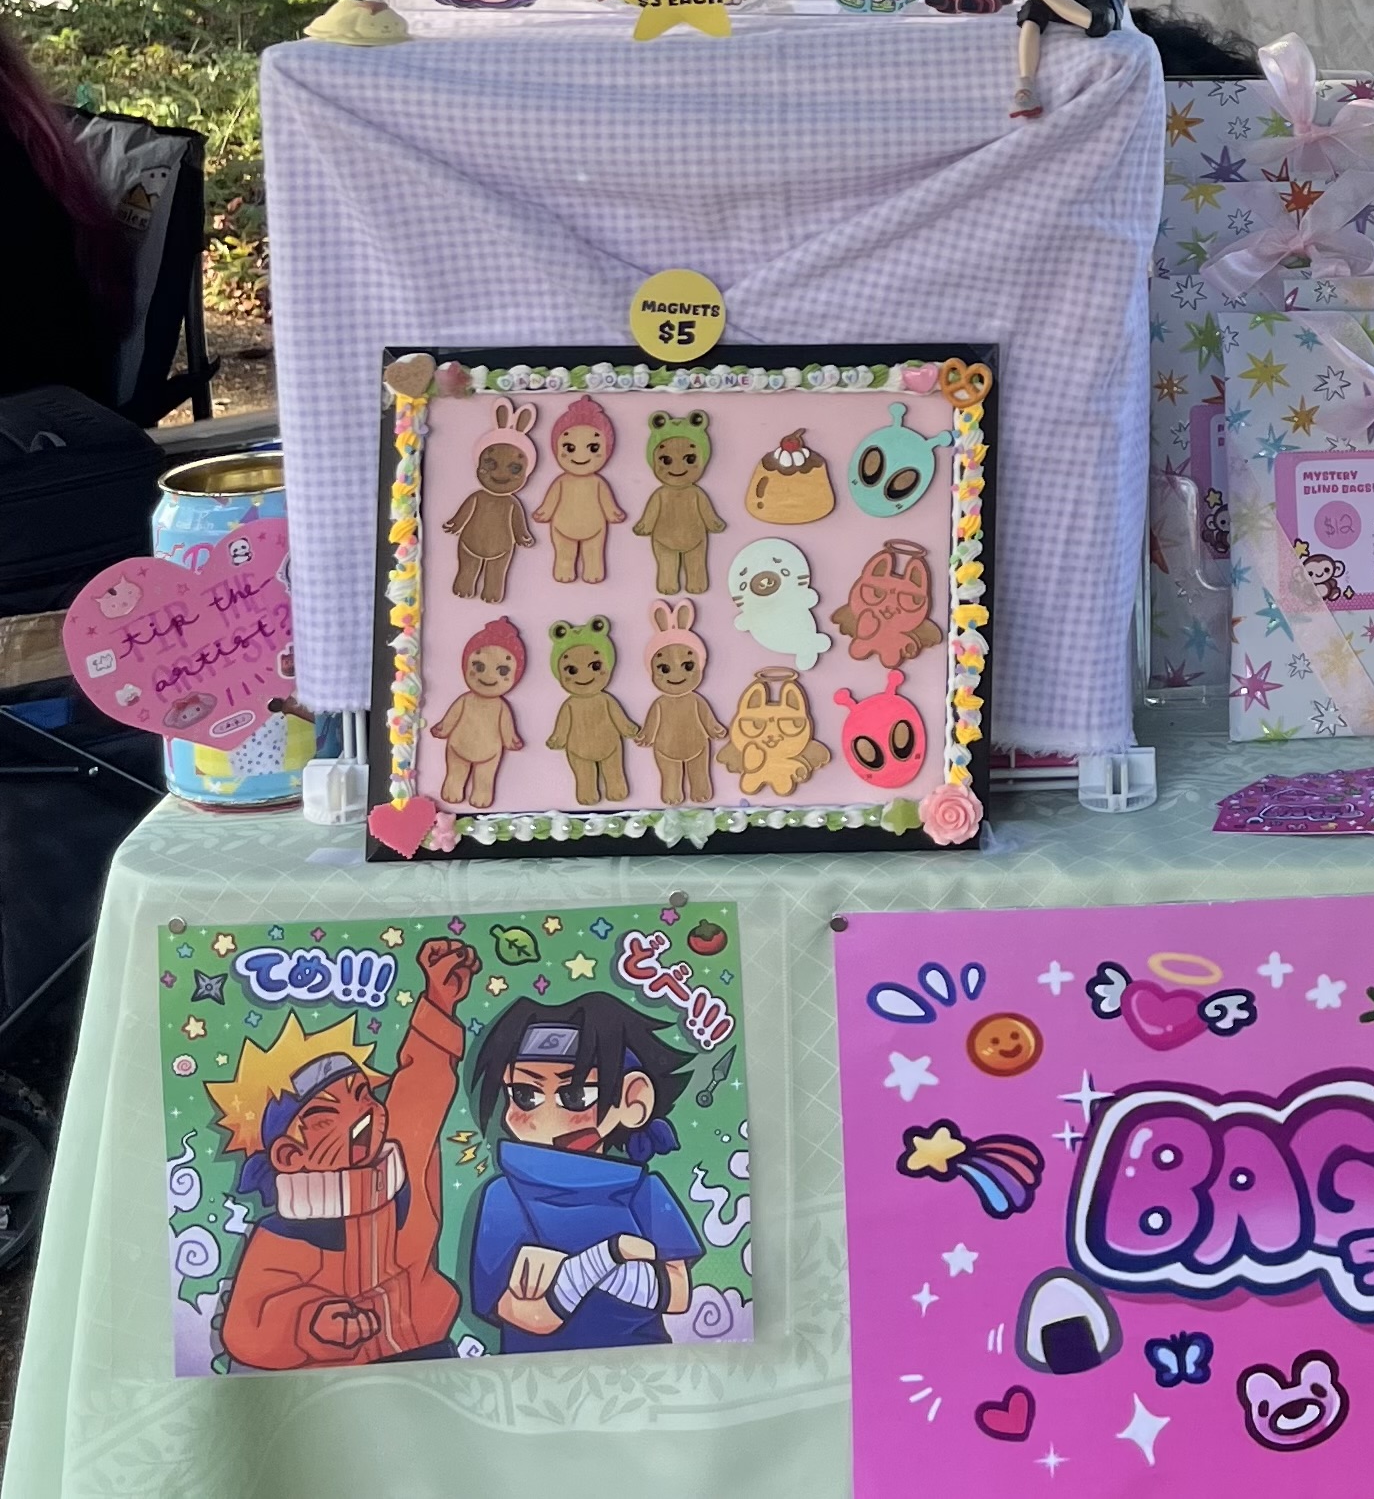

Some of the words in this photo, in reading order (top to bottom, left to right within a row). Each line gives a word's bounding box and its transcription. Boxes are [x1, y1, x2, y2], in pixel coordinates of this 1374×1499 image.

[642, 300, 720, 317] MAGNETS
[659, 320, 696, 344] $5
[1303, 470, 1358, 482] MYSTERY
[1303, 484, 1339, 495] BLIND
[1324, 513, 1355, 538] $12
[119, 613, 200, 659] tip
